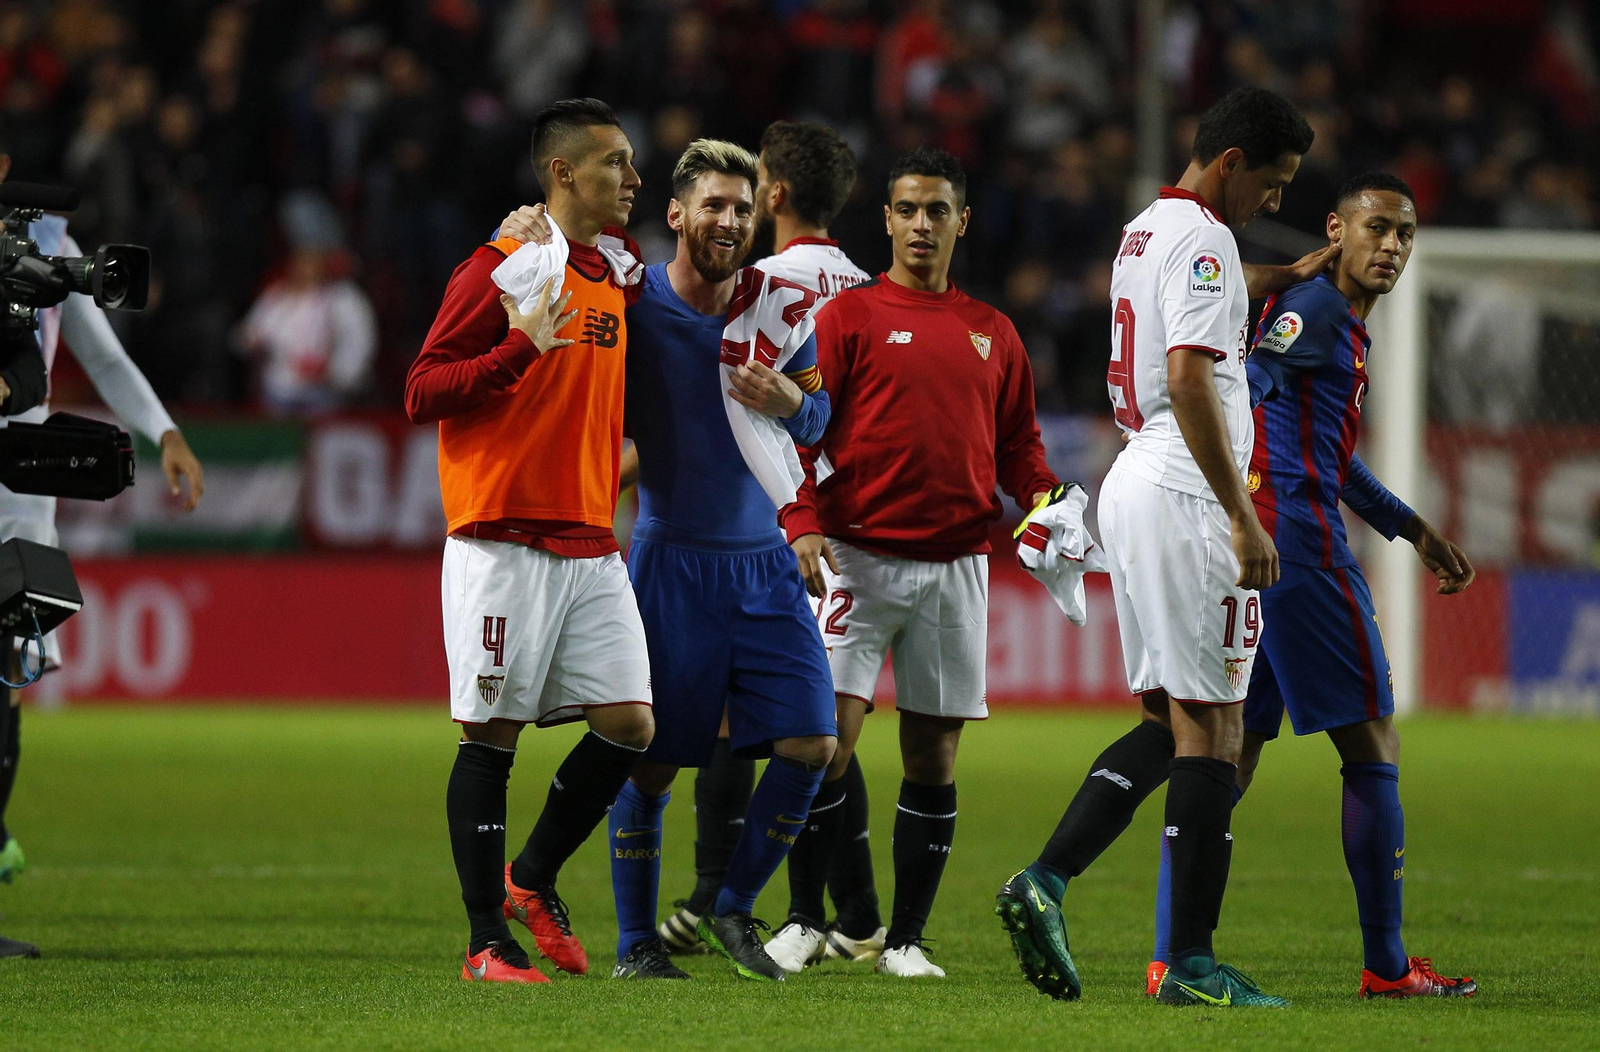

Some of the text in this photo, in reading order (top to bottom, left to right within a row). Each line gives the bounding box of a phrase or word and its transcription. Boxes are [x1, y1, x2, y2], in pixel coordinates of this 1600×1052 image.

[1192, 283, 1221, 293] LaLiga
[816, 589, 854, 635] 2
[1219, 595, 1259, 649] 19
[482, 615, 507, 667] 4
[615, 848, 660, 861] BARÇA
